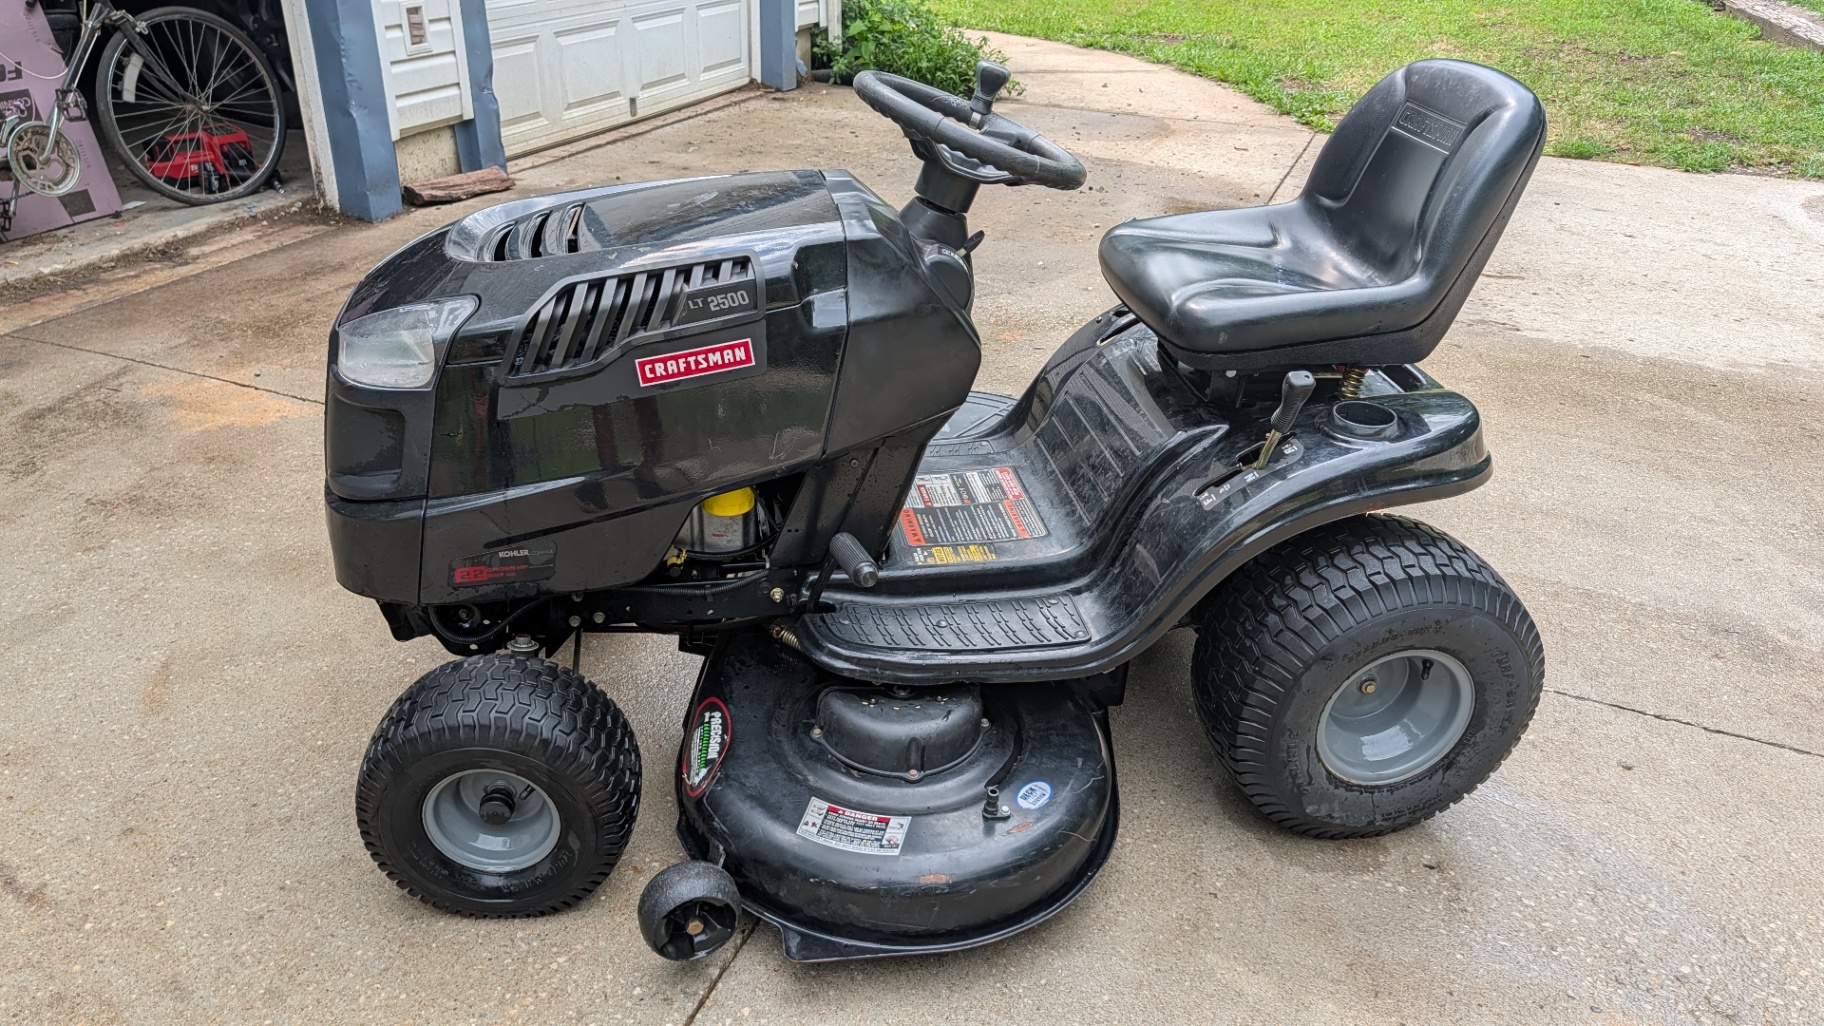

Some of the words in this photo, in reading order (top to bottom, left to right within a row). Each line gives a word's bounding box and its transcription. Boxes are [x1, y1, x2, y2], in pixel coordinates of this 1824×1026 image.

[688, 298, 704, 309] LT
[707, 290, 749, 312] 2500
[644, 346, 747, 378] CRAFTSMAN
[903, 509, 919, 537] WARNING
[499, 549, 529, 558] KOHLER
[460, 568, 485, 580] 22
[707, 711, 722, 759] PRECISION
[844, 810, 878, 821] DANGER
